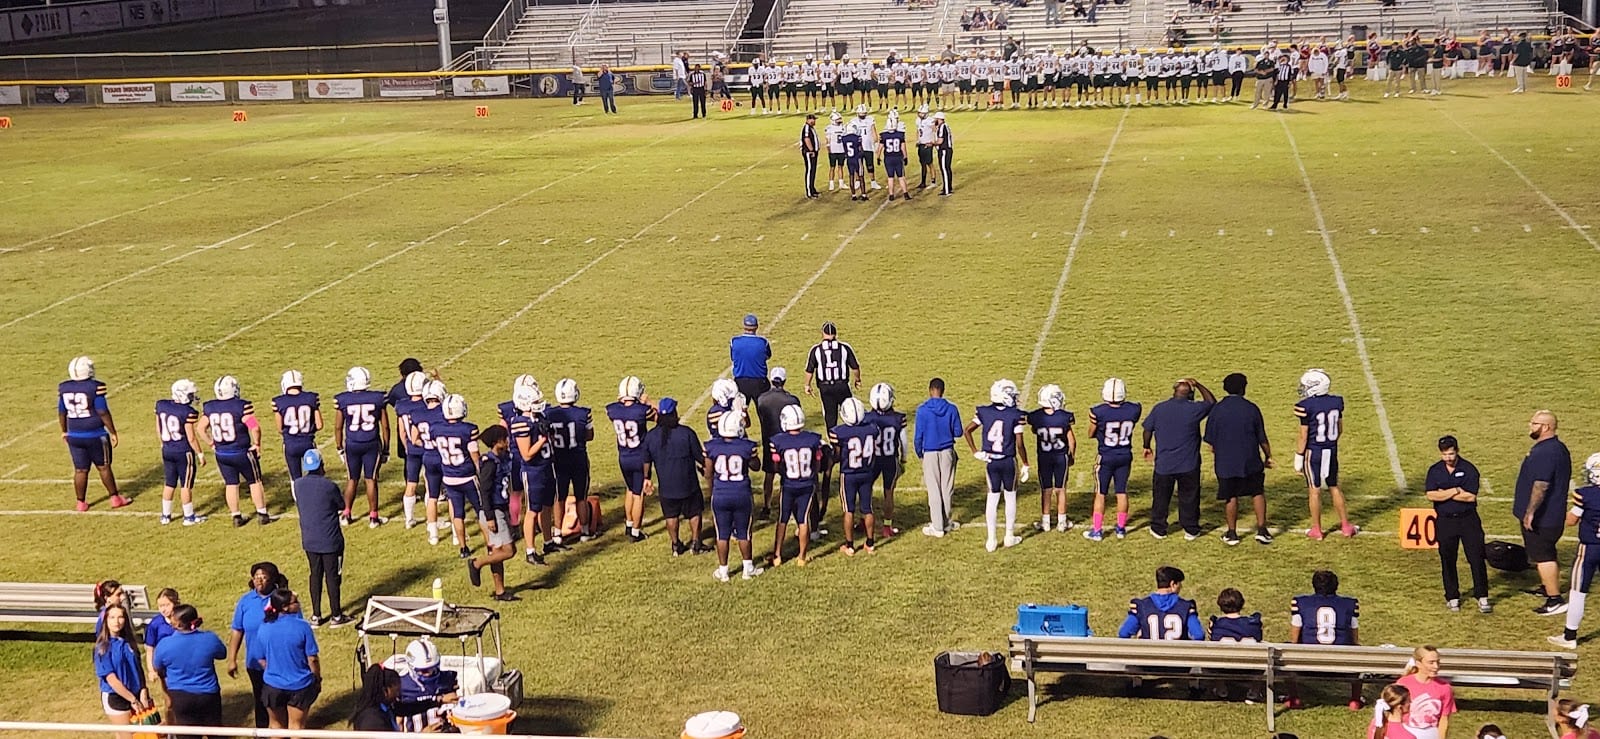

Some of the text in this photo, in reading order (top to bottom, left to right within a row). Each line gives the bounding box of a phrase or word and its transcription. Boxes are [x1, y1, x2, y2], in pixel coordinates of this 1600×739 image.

[35, 12, 61, 33] PRIME
[1558, 76, 1570, 87] 30
[233, 112, 243, 122] 20
[476, 107, 486, 117] 30
[721, 100, 732, 111] 40
[846, 142, 855, 157] 5
[885, 138, 900, 153] 58
[824, 350, 838, 368] L
[62, 392, 92, 419] 52
[283, 404, 312, 435] 40
[346, 403, 376, 432] 75
[208, 412, 236, 443] 69
[550, 421, 578, 449] 51
[612, 419, 641, 449] 83
[987, 420, 1005, 453] 4
[1037, 427, 1065, 451] 35
[1104, 420, 1135, 447] 50
[1315, 409, 1341, 443] 10
[435, 436, 465, 467] 65
[783, 447, 812, 480] 88
[847, 434, 874, 469] 24
[714, 454, 745, 482] 49
[1406, 514, 1438, 546] 40
[1147, 614, 1183, 641] 12
[1315, 606, 1337, 645] 8
